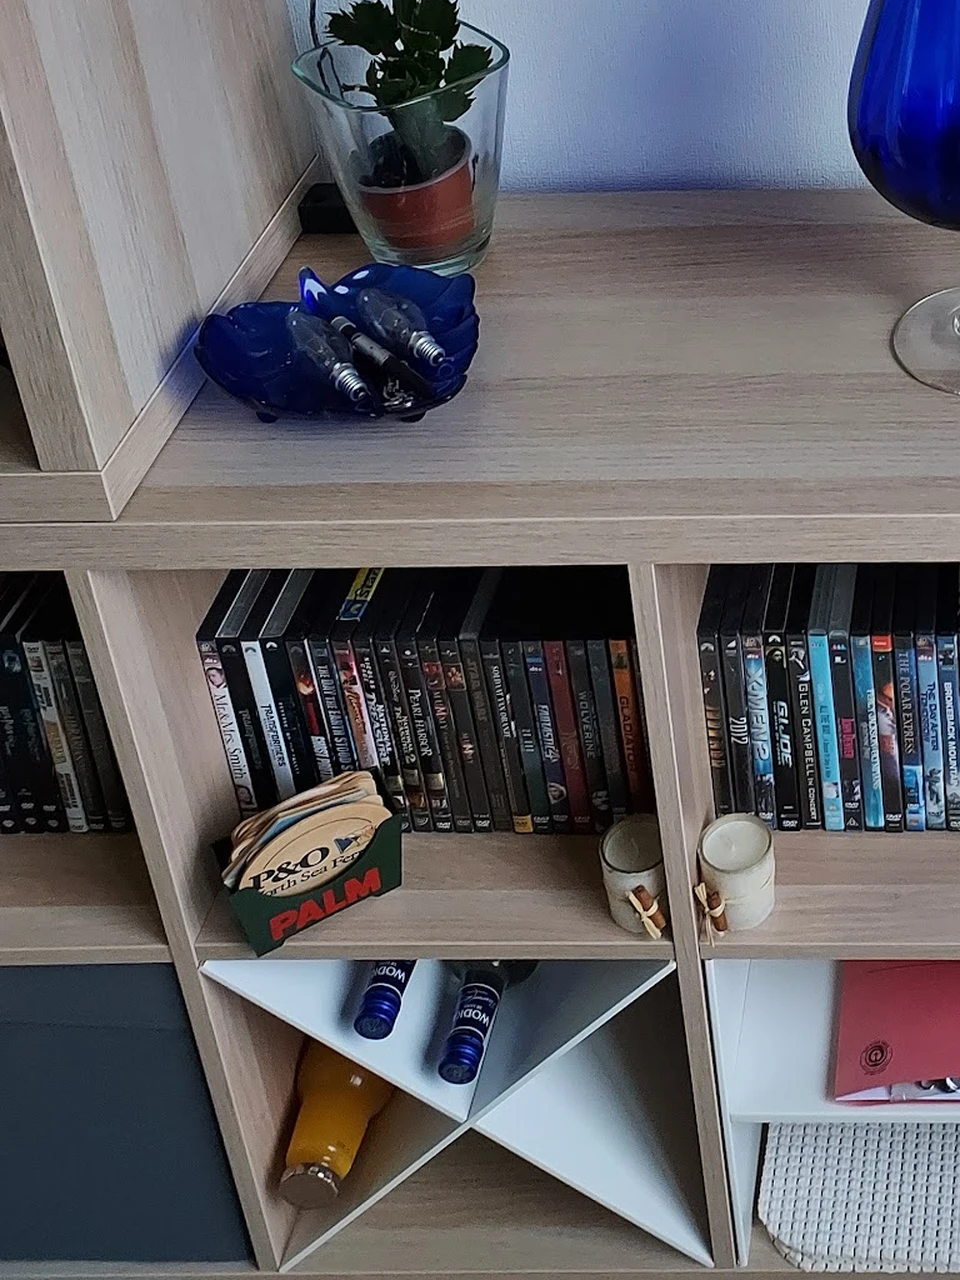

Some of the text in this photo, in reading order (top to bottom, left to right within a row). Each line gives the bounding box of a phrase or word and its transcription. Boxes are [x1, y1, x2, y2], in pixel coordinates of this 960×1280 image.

[317, 665, 329, 678] THE
[319, 679, 334, 696] DAY
[466, 658, 488, 722] STAR WARS
[324, 697, 338, 708] THE
[432, 691, 448, 730] MUMMY
[798, 683, 809, 714] GLEN
[898, 652, 915, 754] THE POLAR EXPRESS
[921, 692, 930, 742] TOMORROW
[927, 683, 938, 751] THE DAY AFTER
[261, 704, 286, 767] TRANSFORMERS
[329, 710, 345, 736] EARTH
[366, 692, 390, 766] TREASURE
[376, 704, 393, 753] NATIONAL
[393, 706, 416, 764] TREASURE 2
[402, 716, 414, 751] NATIONAL
[408, 689, 432, 757] PEARL HARBOR
[538, 704, 555, 749] FANTASTIC
[579, 692, 596, 759] WOLVERINE
[620, 697, 637, 772] GLADIATOR
[729, 716, 748, 745] 2012
[944, 682, 958, 788] BROKEBACK MOUNTAIN
[227, 748, 247, 779] Smith
[334, 737, 351, 761] STOOD
[802, 719, 814, 776] CAMPBELL
[808, 787, 816, 820] CONCERT
[249, 847, 329, 890] P&O
[259, 879, 296, 896] orth
[301, 866, 327, 882] Sea
[270, 868, 381, 941] PALM
